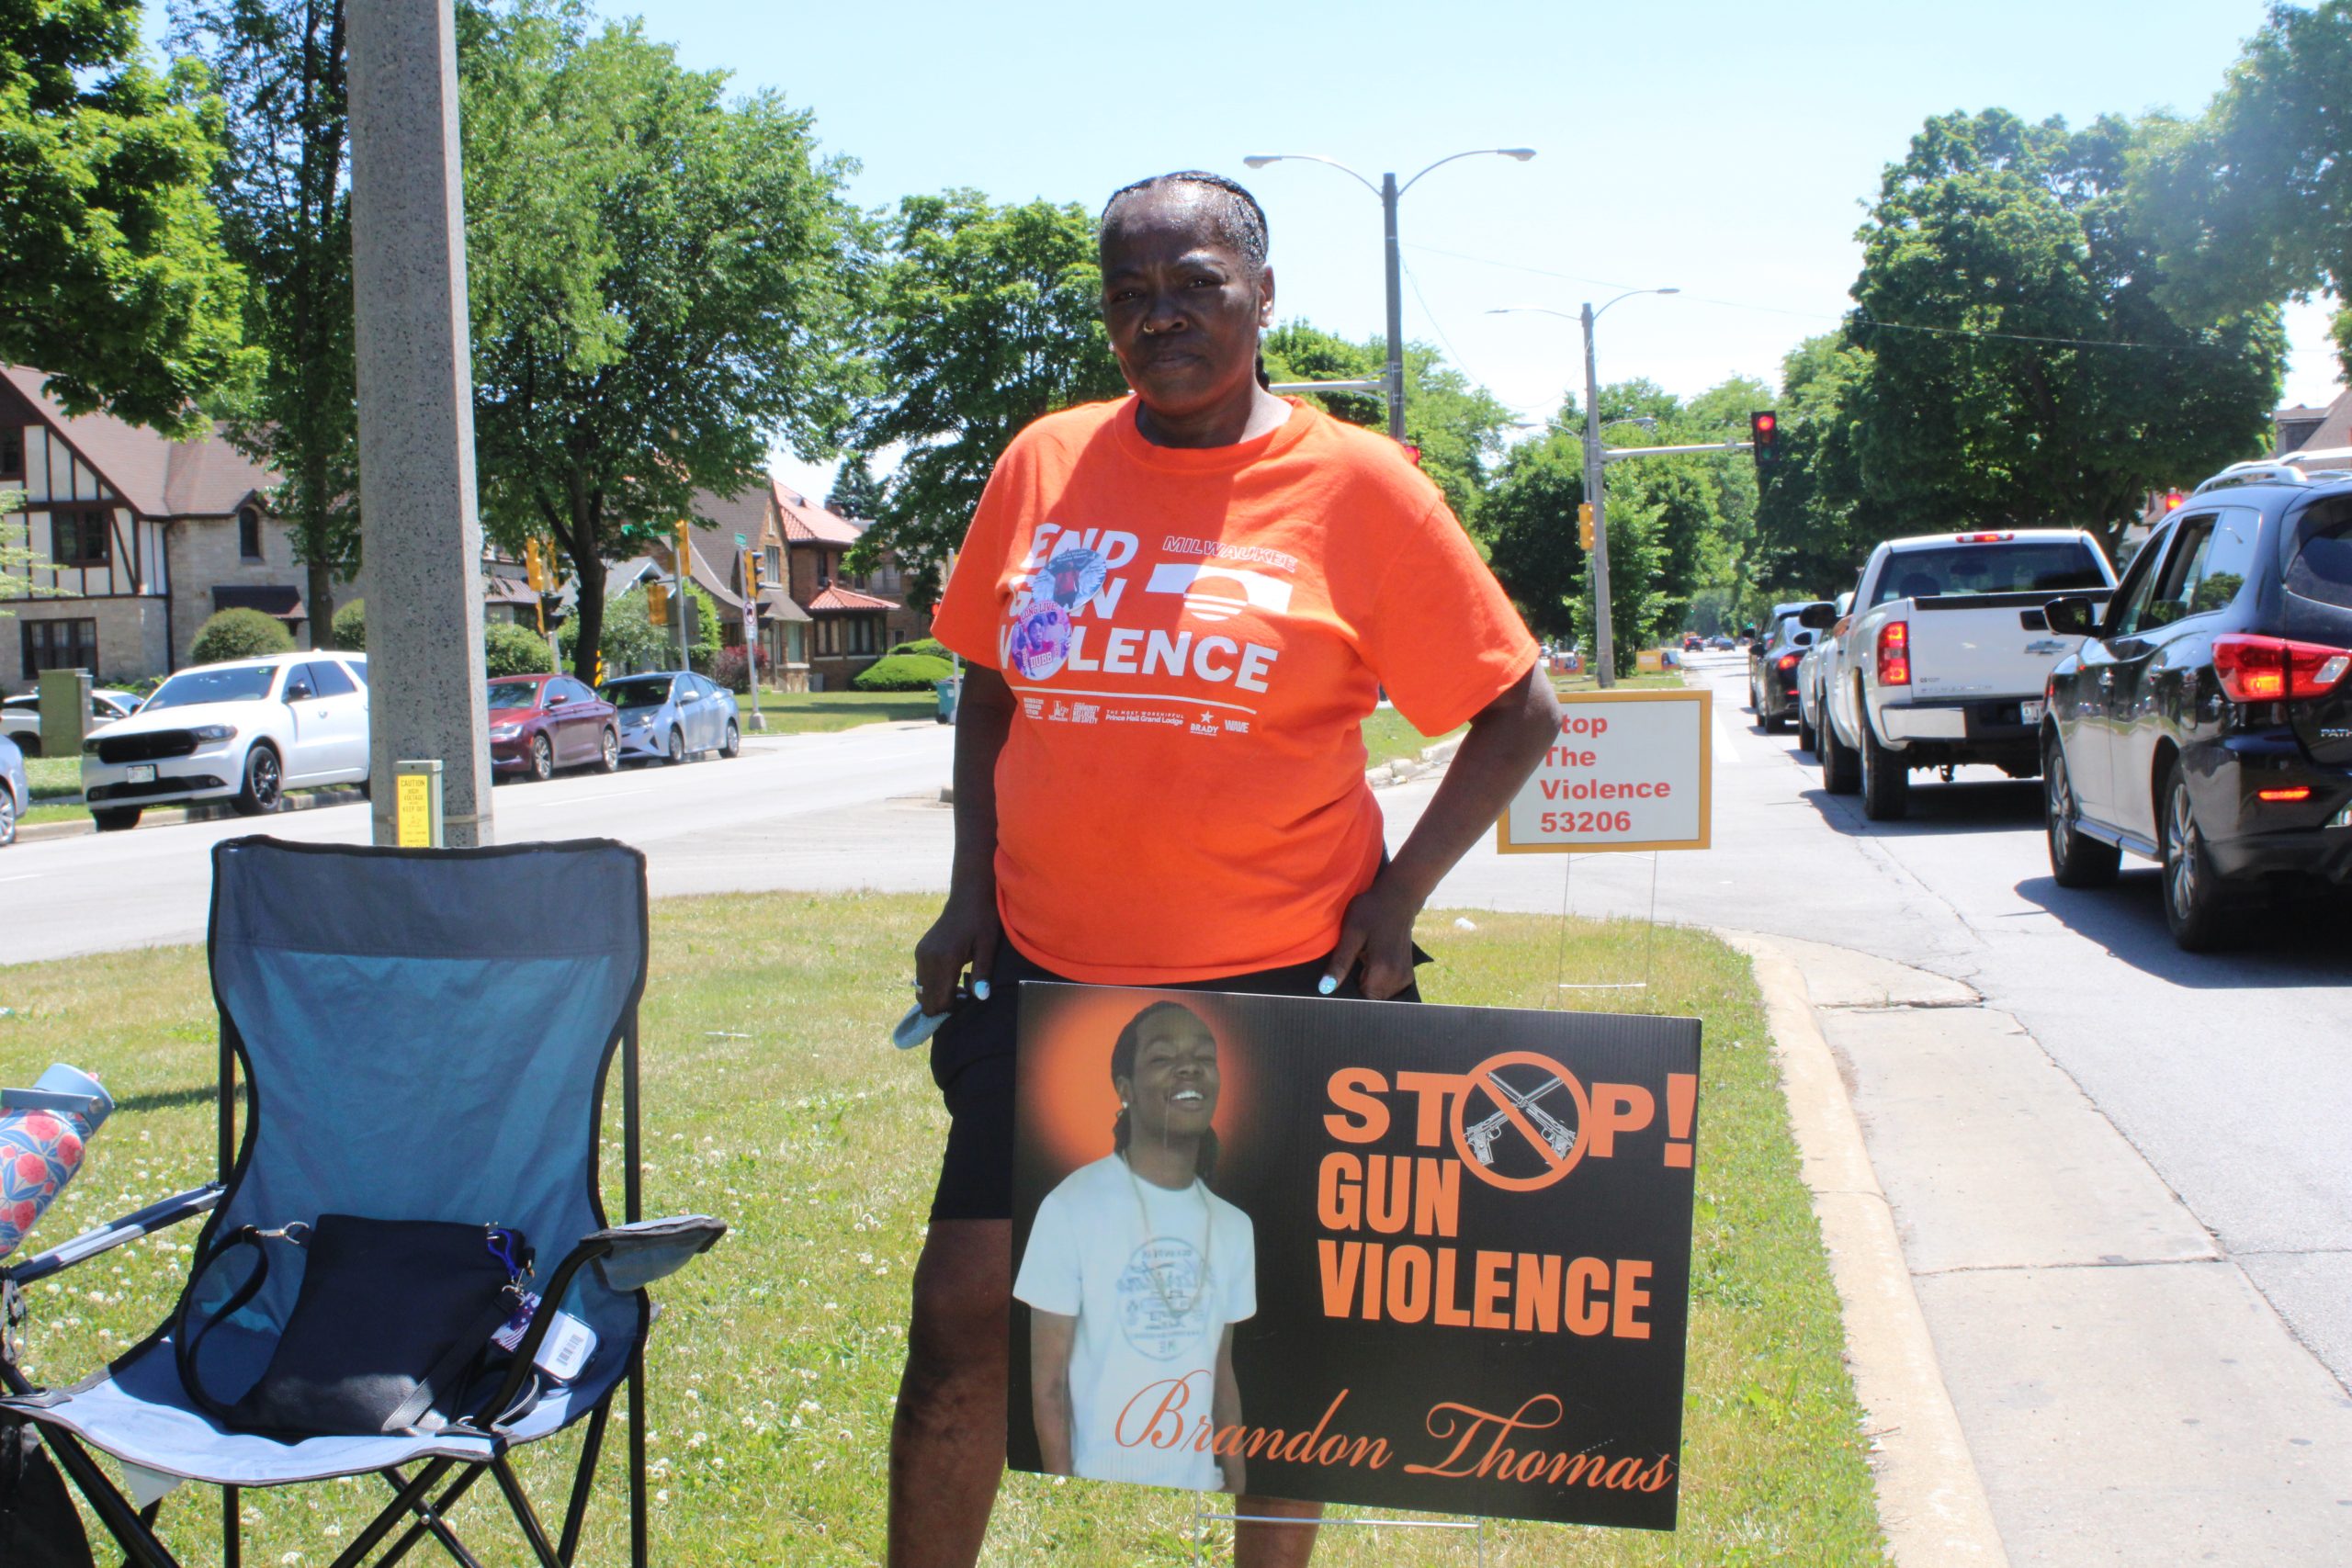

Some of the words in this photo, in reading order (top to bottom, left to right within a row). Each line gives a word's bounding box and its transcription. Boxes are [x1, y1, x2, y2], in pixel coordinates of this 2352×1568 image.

[1019, 522, 1139, 569] END
[1162, 536, 1298, 573] MILWAUKEE
[1008, 574, 1128, 620] GN
[999, 625, 1279, 694] VLENCE
[1161, 717, 1183, 726] Lodge
[1190, 723, 1219, 733] BRADY
[1225, 719, 1250, 733] WAVE
[1561, 714, 1608, 739] top
[1545, 746, 1597, 767] The
[401, 779, 426, 787] CAUTION
[1540, 779, 1671, 800] Violence
[1540, 811, 1632, 833] 53206
[1317, 1152, 1461, 1237] GUN
[1317, 1239, 1653, 1339] VIOLENCE
[1114, 1370, 1393, 1470] Brandon
[1404, 1393, 1673, 1492] Thomas
